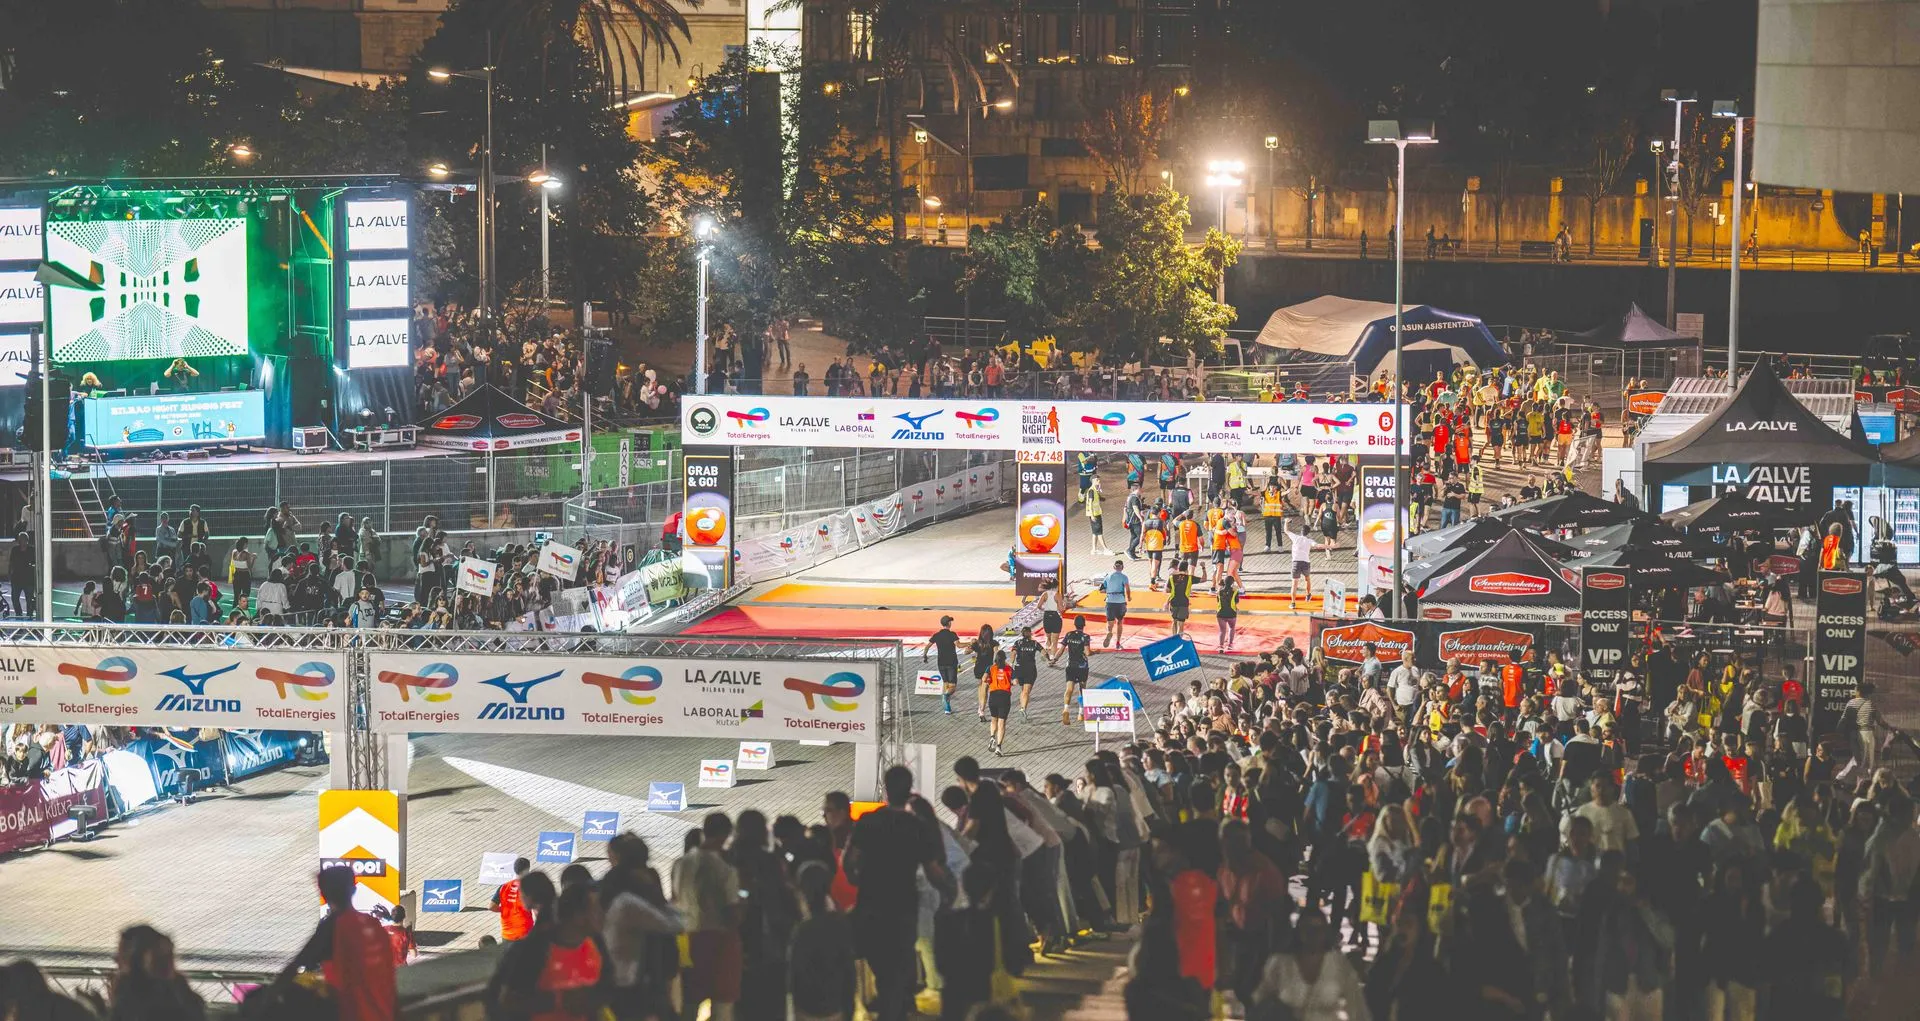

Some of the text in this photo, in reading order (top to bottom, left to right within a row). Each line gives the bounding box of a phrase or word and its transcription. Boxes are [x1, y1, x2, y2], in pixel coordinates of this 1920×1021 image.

[348, 215, 408, 227] LA SALVE
[349, 275, 408, 287] LA SALVE
[1389, 320, 1474, 332] OASUN ASISTENTZIA
[349, 333, 408, 346] LA SALVE
[780, 417, 830, 427] LA SALVE
[1022, 415, 1047, 424] BILBAO
[1022, 425, 1046, 434] NIGHT
[1250, 425, 1302, 435] LA SALVE
[1726, 421, 1798, 432] LA SALVE
[727, 432, 770, 440] TotalEnergies
[890, 429, 945, 440] MIZUNO
[956, 433, 1000, 441] TotalEnergies
[1022, 436, 1055, 444] RUNNING FEST
[1137, 431, 1191, 443] MIZUNO
[1200, 432, 1241, 440] LABORAL
[1081, 437, 1126, 445] TotalEnergies
[1313, 438, 1358, 446] TotalEnergies
[1368, 435, 1404, 446] Bilba
[1017, 450, 1063, 462] 02:47:48
[687, 465, 718, 476] GRAB
[1712, 465, 1811, 484] LA SALVE
[688, 477, 718, 487] & GO!
[1022, 472, 1053, 482] GRAB
[1022, 483, 1052, 493] & GO!
[1365, 487, 1374, 498] &
[1746, 485, 1812, 503] SALVE
[1474, 578, 1546, 590] Streetmarketing
[142, 586, 148, 595] 7
[1460, 611, 1557, 621] WWW.STREETMARKETING.ES
[1583, 610, 1628, 619] ACCESS
[1818, 615, 1864, 625] ACCESS
[1591, 623, 1619, 632] ONLY
[1826, 628, 1856, 638] ONLY
[1327, 634, 1408, 653] Streetmrketing
[1445, 638, 1527, 656] Streetmarketing
[1588, 648, 1622, 665] VIP
[1155, 659, 1190, 676] MIZUNO
[1822, 654, 1858, 671] VIP
[685, 669, 762, 686] LA SALVE
[1820, 675, 1858, 685] MEDIA
[58, 702, 138, 716] TotalEnergies
[154, 694, 241, 713] MIZUNO
[1824, 702, 1846, 711] JUE
[256, 707, 336, 721] TotalEnergies
[477, 702, 565, 721] MIZUNO
[683, 707, 739, 718] LABORAL
[1087, 707, 1119, 715] LABORAL
[379, 710, 460, 724] TotalEnergies
[582, 712, 664, 726] TotalEnergies
[784, 717, 866, 732] TotalEnergies
[585, 827, 616, 835] MIZUNO
[539, 849, 571, 857] MIZUNO
